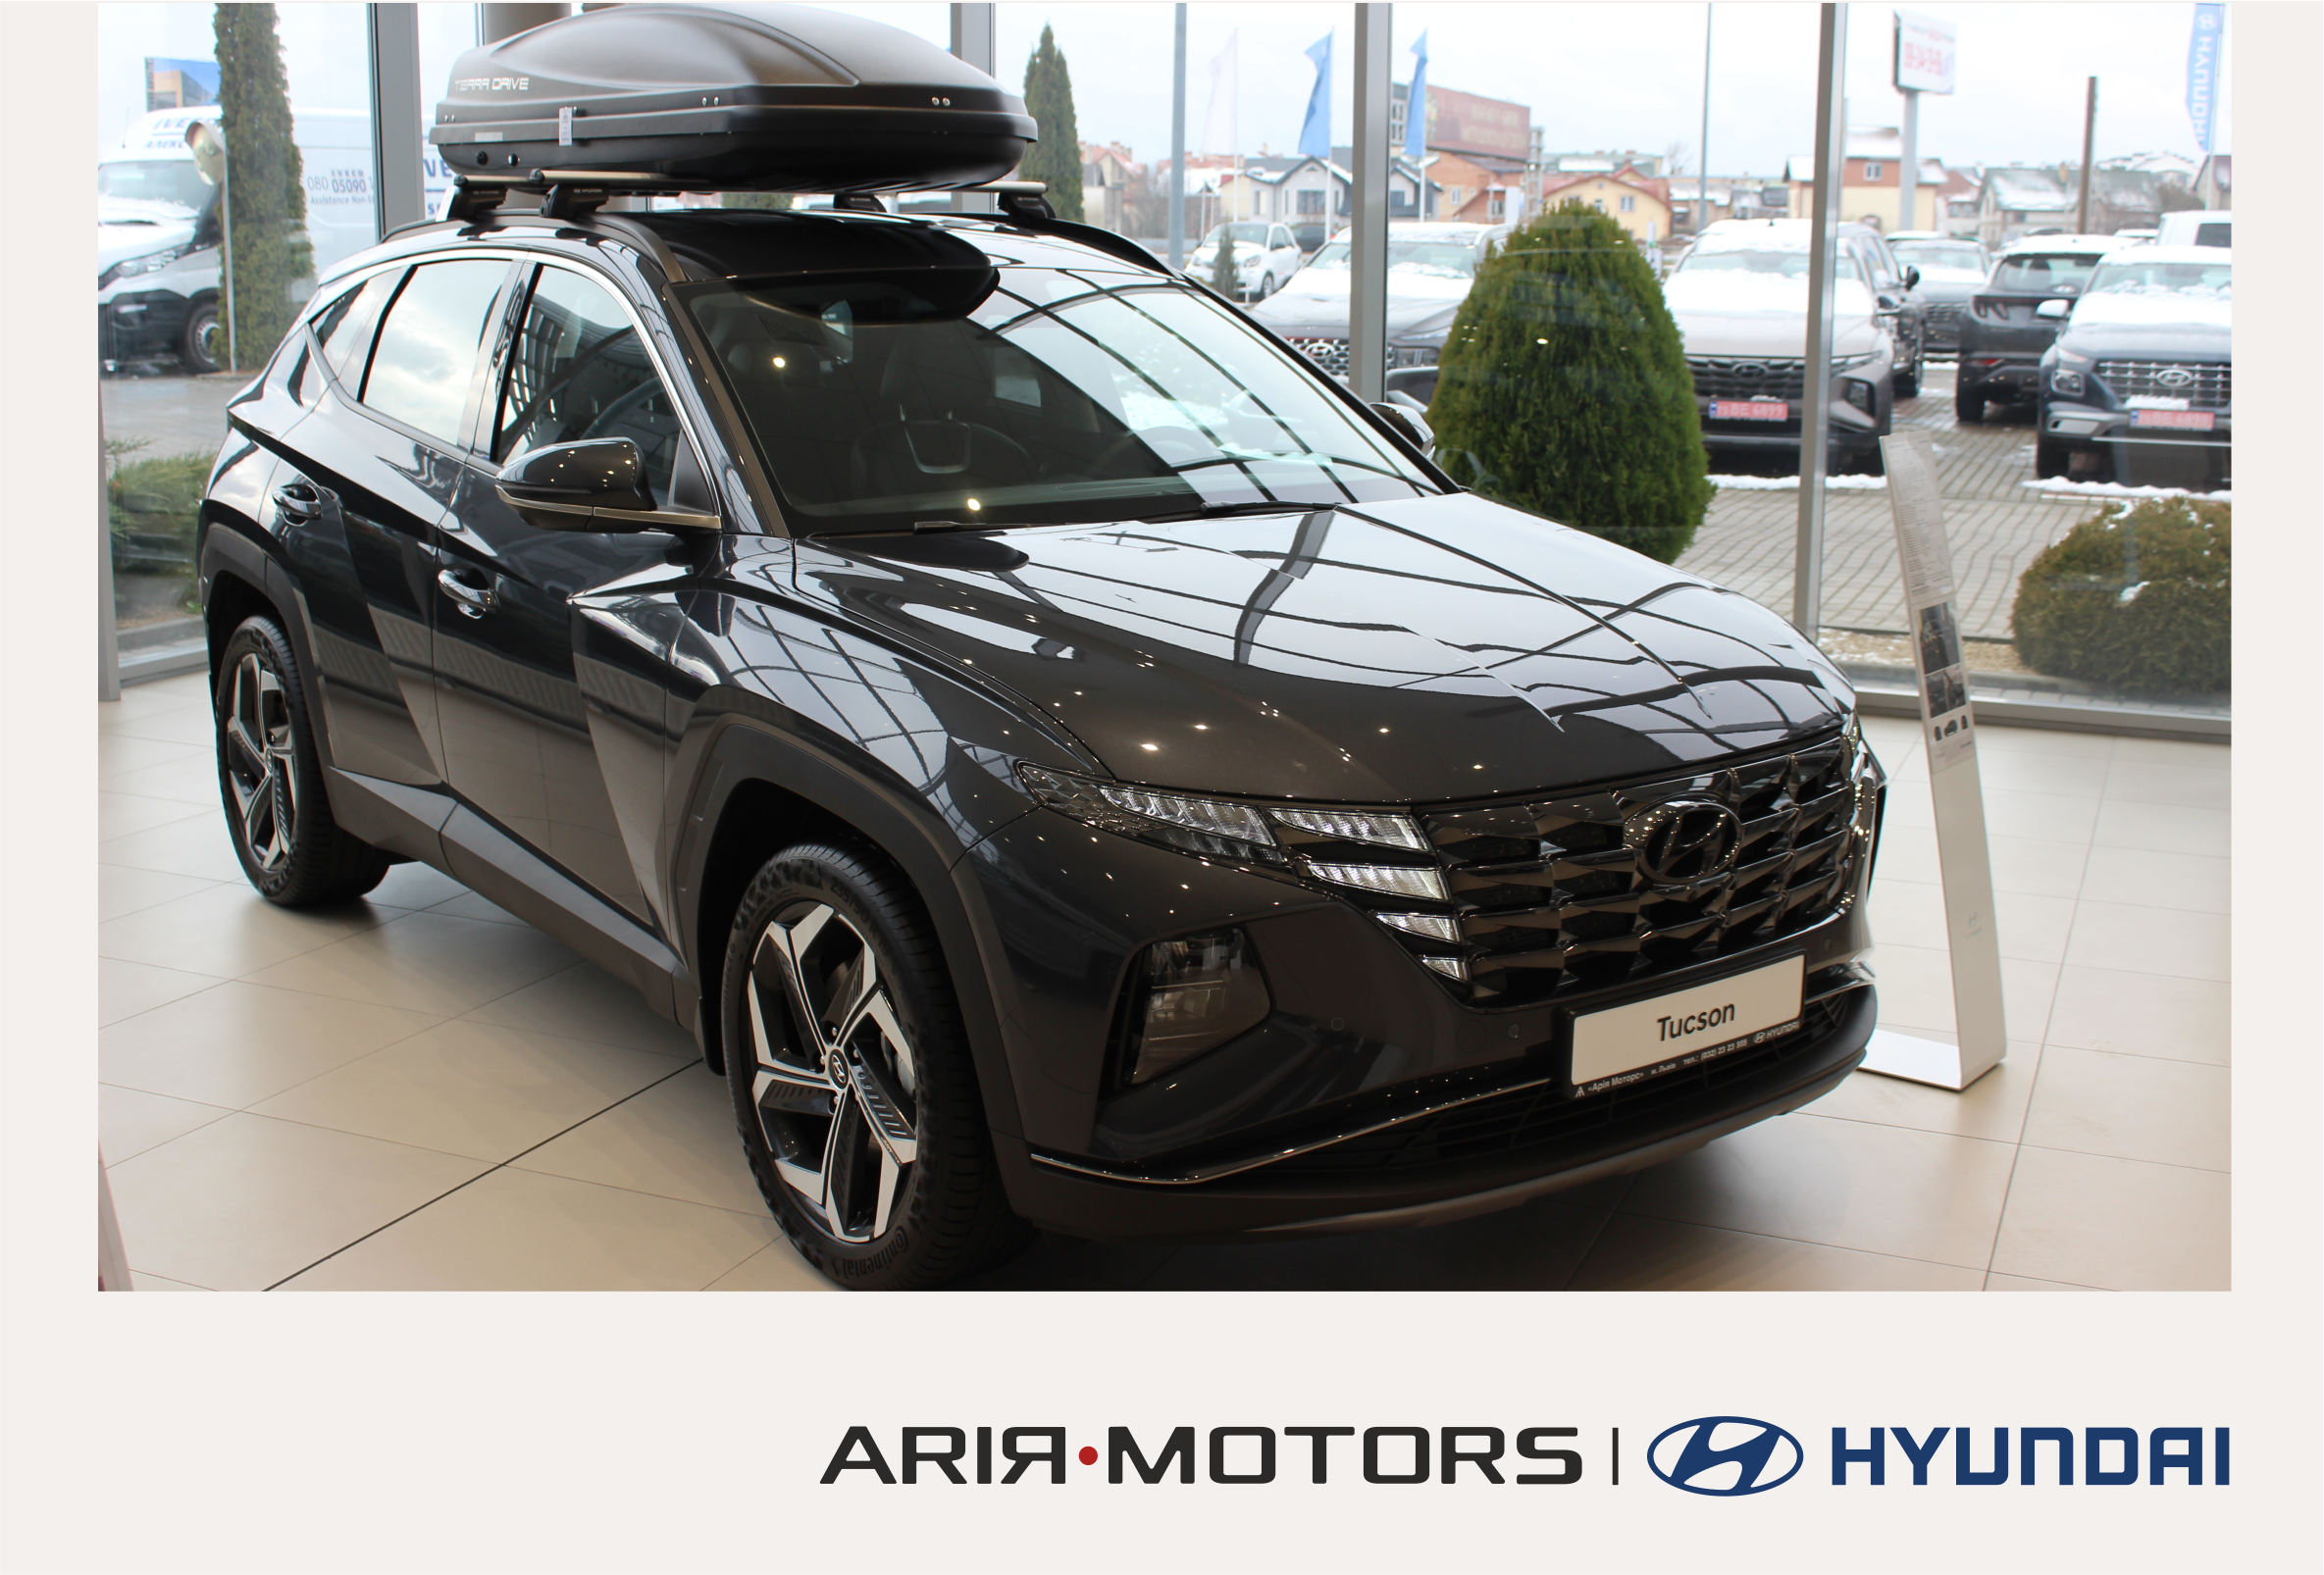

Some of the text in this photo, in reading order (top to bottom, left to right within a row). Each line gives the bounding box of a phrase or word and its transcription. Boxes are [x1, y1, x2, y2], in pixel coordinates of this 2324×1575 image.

[455, 77, 529, 91] TERRA DRIVE
[307, 176, 329, 190] 080
[332, 179, 367, 193] 05090
[310, 195, 375, 205] Assistance Non-S
[1657, 1003, 1735, 1042] Tucson
[1766, 1020, 1800, 1039] HYUNDAI
[842, 1225, 909, 1280] Continental
